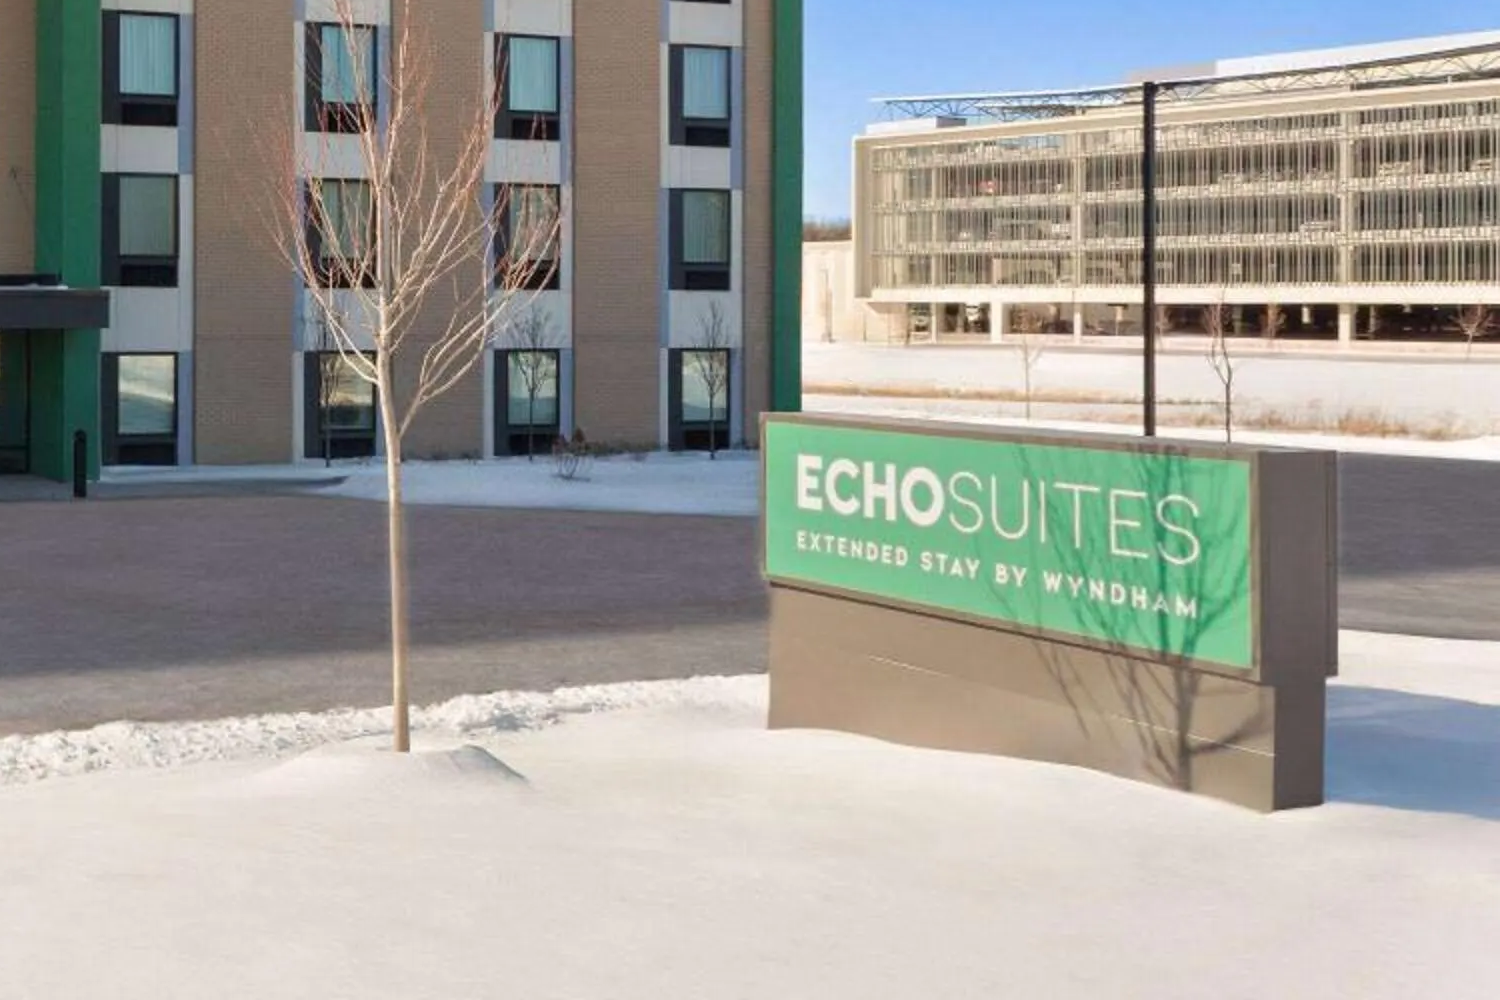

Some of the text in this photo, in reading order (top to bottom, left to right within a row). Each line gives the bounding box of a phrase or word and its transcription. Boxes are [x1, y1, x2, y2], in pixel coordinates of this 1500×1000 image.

[797, 530, 1198, 618] EXTENDED STAY BY WYNDHAM
